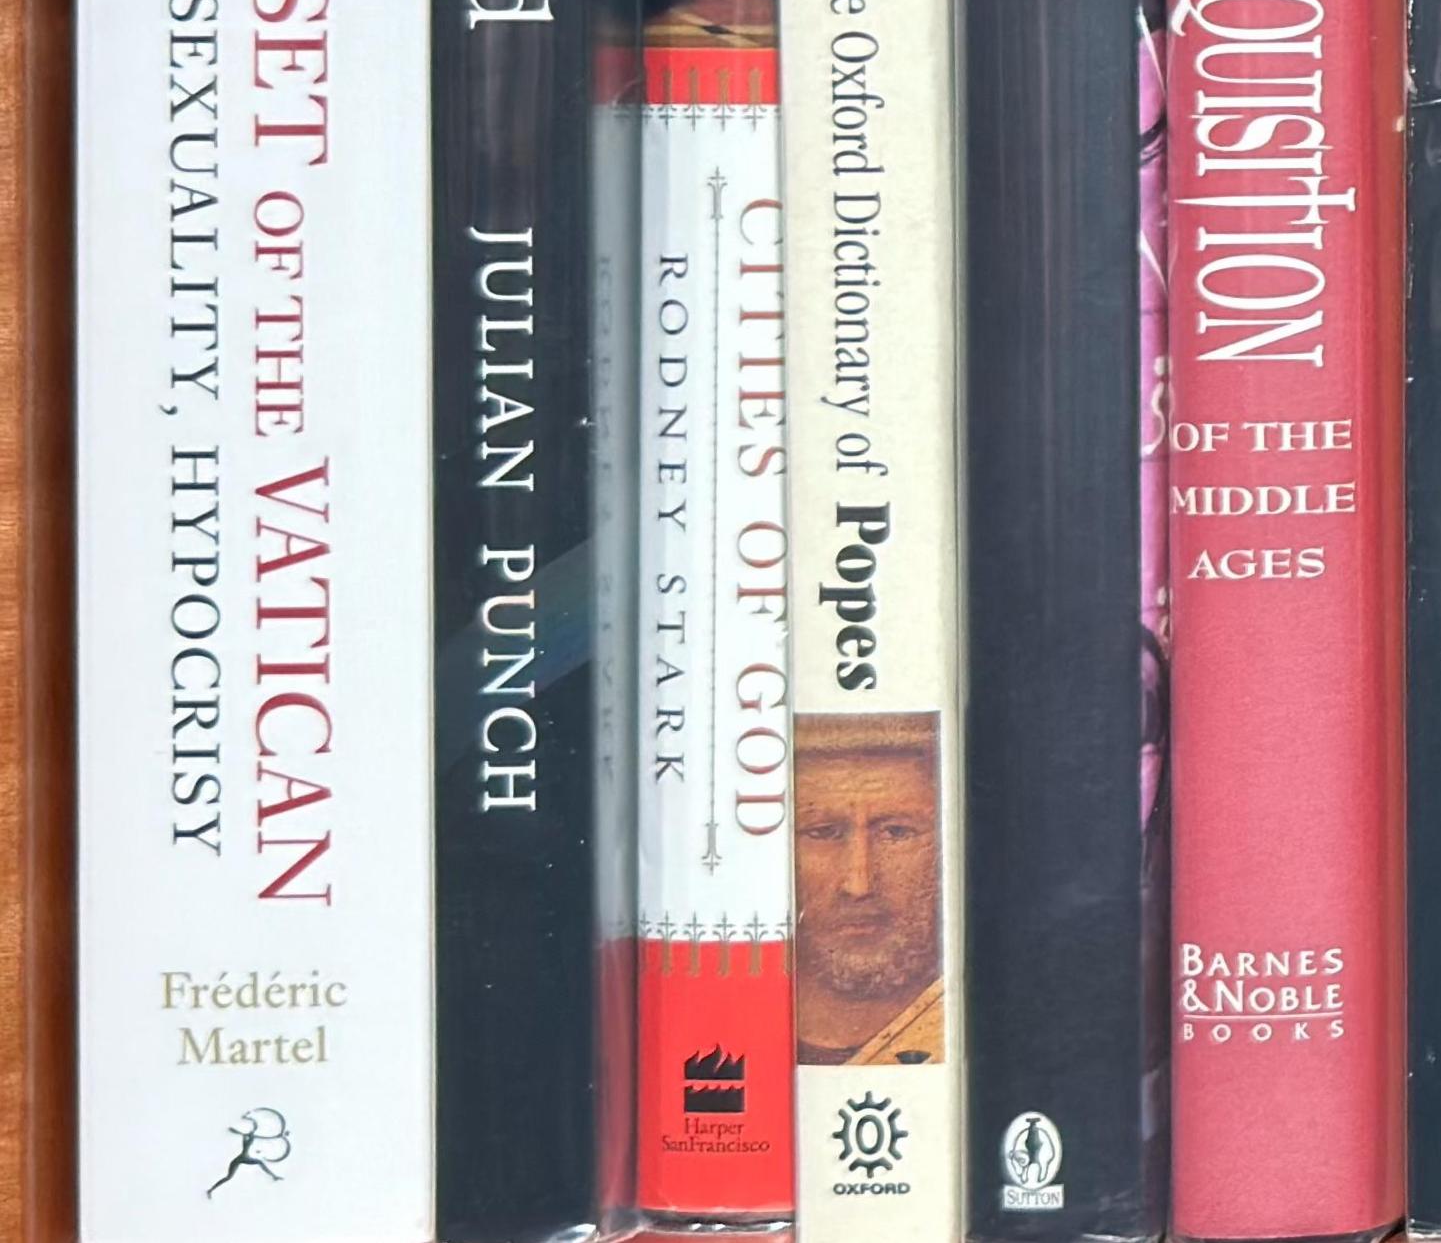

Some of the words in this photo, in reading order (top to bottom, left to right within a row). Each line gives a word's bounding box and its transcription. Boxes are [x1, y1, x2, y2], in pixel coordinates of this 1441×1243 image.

[830, 31, 881, 176] Oxford
[256, 191, 304, 280] OF
[254, 294, 304, 437] THE
[469, 227, 535, 491] JULIAN
[736, 197, 789, 478] CITIES
[820, 191, 880, 417] Dictionary
[659, 254, 689, 532] RODNEY
[835, 433, 889, 477] of
[1172, 422, 1229, 453] OF
[1240, 419, 1353, 451] THE
[1171, 482, 1356, 517] MIDDLE
[736, 522, 789, 631] OF
[818, 502, 891, 691] Popes
[1187, 548, 1327, 580] AGES
[169, 445, 222, 854] HYPOCRISY
[254, 455, 333, 906] VATICAN
[481, 545, 536, 812] PUNCH
[655, 572, 686, 783] STARK
[736, 664, 789, 836] GOD
[161, 969, 348, 1010] Frédéric
[1182, 943, 1344, 978] BARNES
[178, 1028, 328, 1063] Martel
[1183, 1021, 1344, 1042] BOOKS
[684, 1117, 744, 1139] Harper
[833, 1183, 909, 1194] OXFORD
